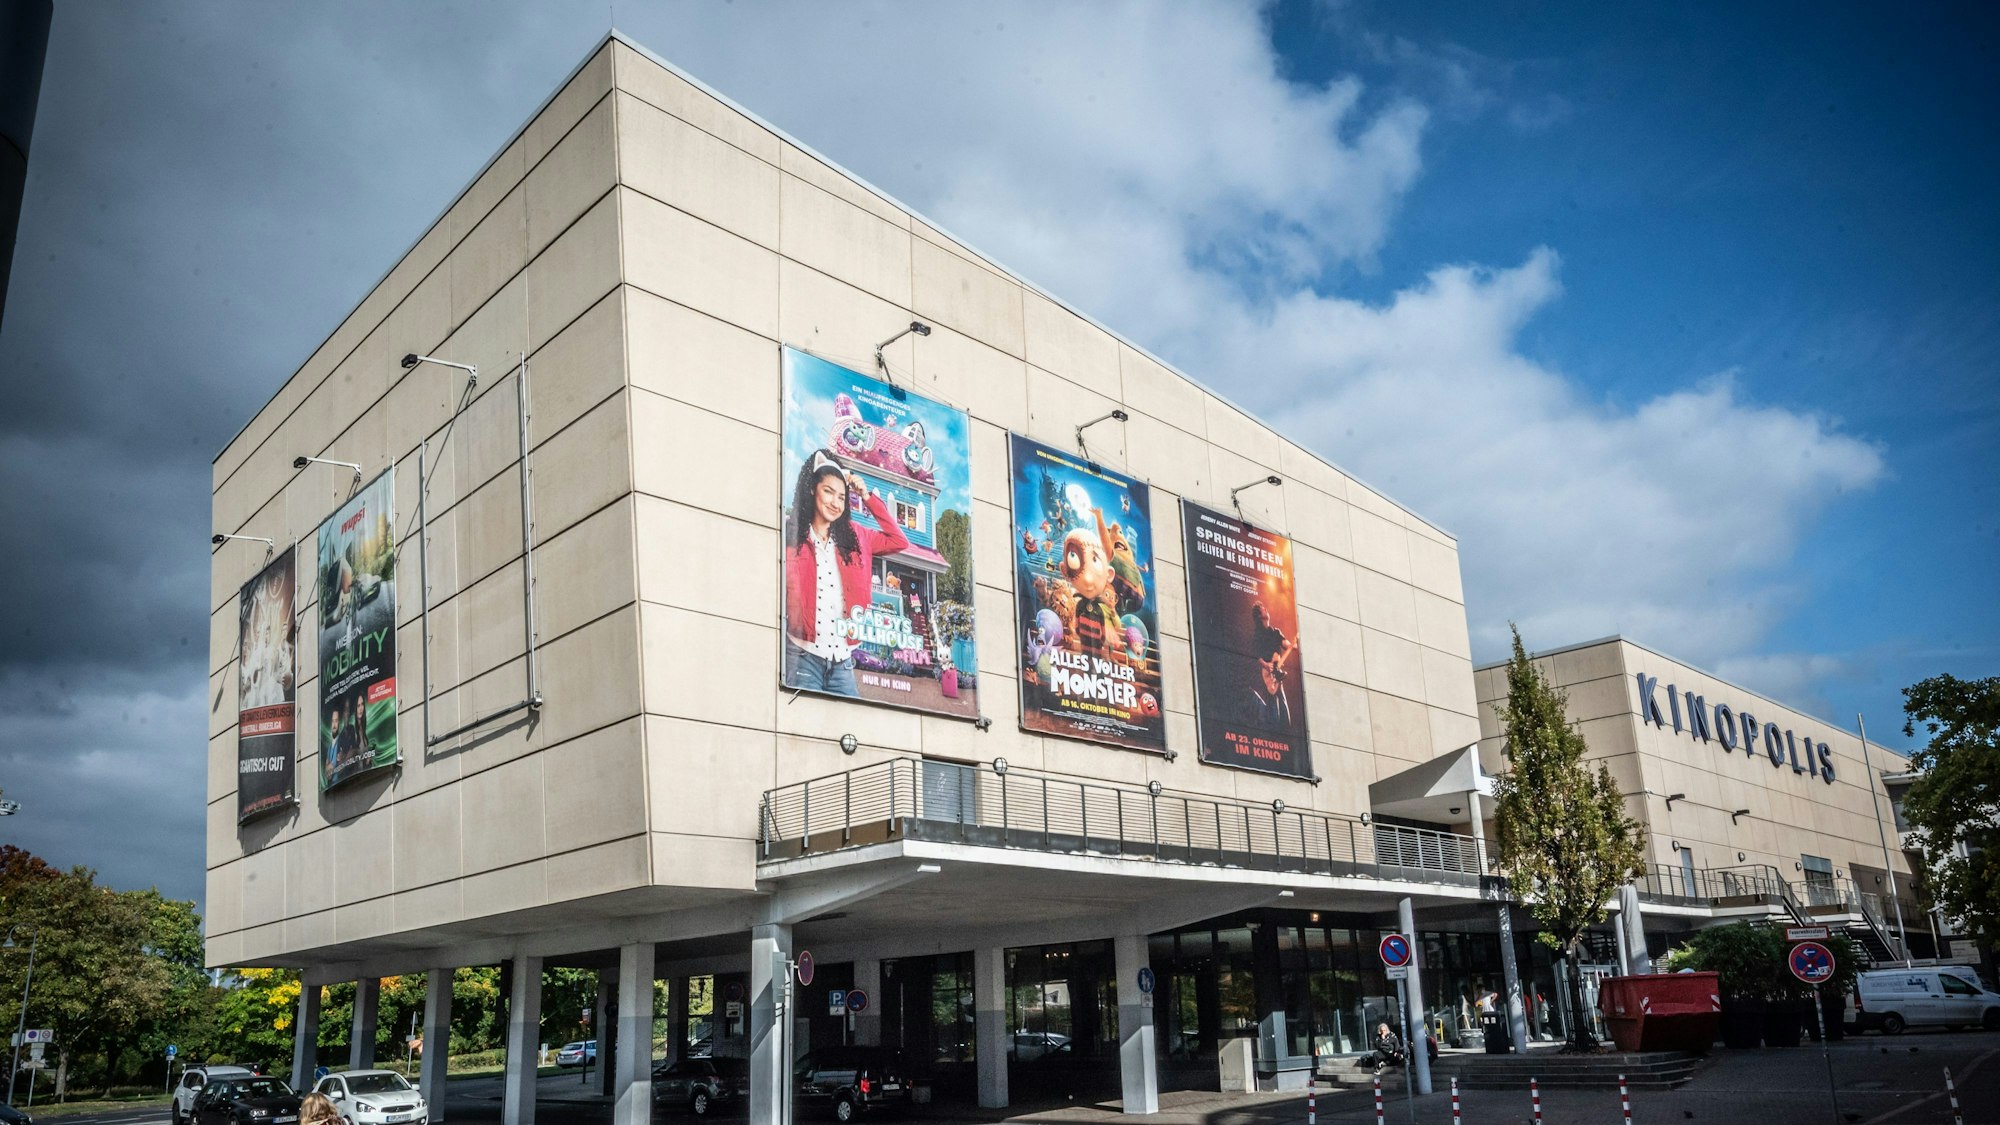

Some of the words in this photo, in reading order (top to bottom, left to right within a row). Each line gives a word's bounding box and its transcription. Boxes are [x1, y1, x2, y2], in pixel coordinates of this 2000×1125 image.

[851, 384, 863, 394] EIN
[857, 395, 906, 417] KINOABENTEUER
[341, 500, 365, 536] wupsi
[1196, 526, 1284, 567] SPRINGSTEEN
[1197, 541, 1224, 559] DELIVER
[1226, 550, 1237, 563] ME
[1238, 554, 1255, 570] FROM
[851, 604, 912, 635] GABBY'S
[836, 619, 924, 652] DOLLHOUSE
[322, 626, 389, 688] MOBILITY
[902, 648, 931, 666] FILM
[1050, 648, 1090, 672] ALLES
[1091, 657, 1135, 682] VOLLER
[862, 674, 879, 686] NUR
[881, 678, 891, 688] IM
[892, 679, 912, 692] KINO
[1050, 666, 1138, 709] MONSTER
[1061, 699, 1071, 707] AB
[1071, 700, 1079, 709] 16.
[1080, 703, 1109, 714] OKTOBER
[1116, 708, 1131, 719] KINO
[1637, 672, 1836, 785] KINOPOLIS
[1225, 731, 1237, 742] AB
[1238, 735, 1251, 744] 23.
[1253, 737, 1290, 752] OKTOBER
[1235, 743, 1250, 756] IM
[1253, 747, 1282, 761] KINO
[268, 756, 285, 772] GUT
[832, 992, 842, 1005] P
